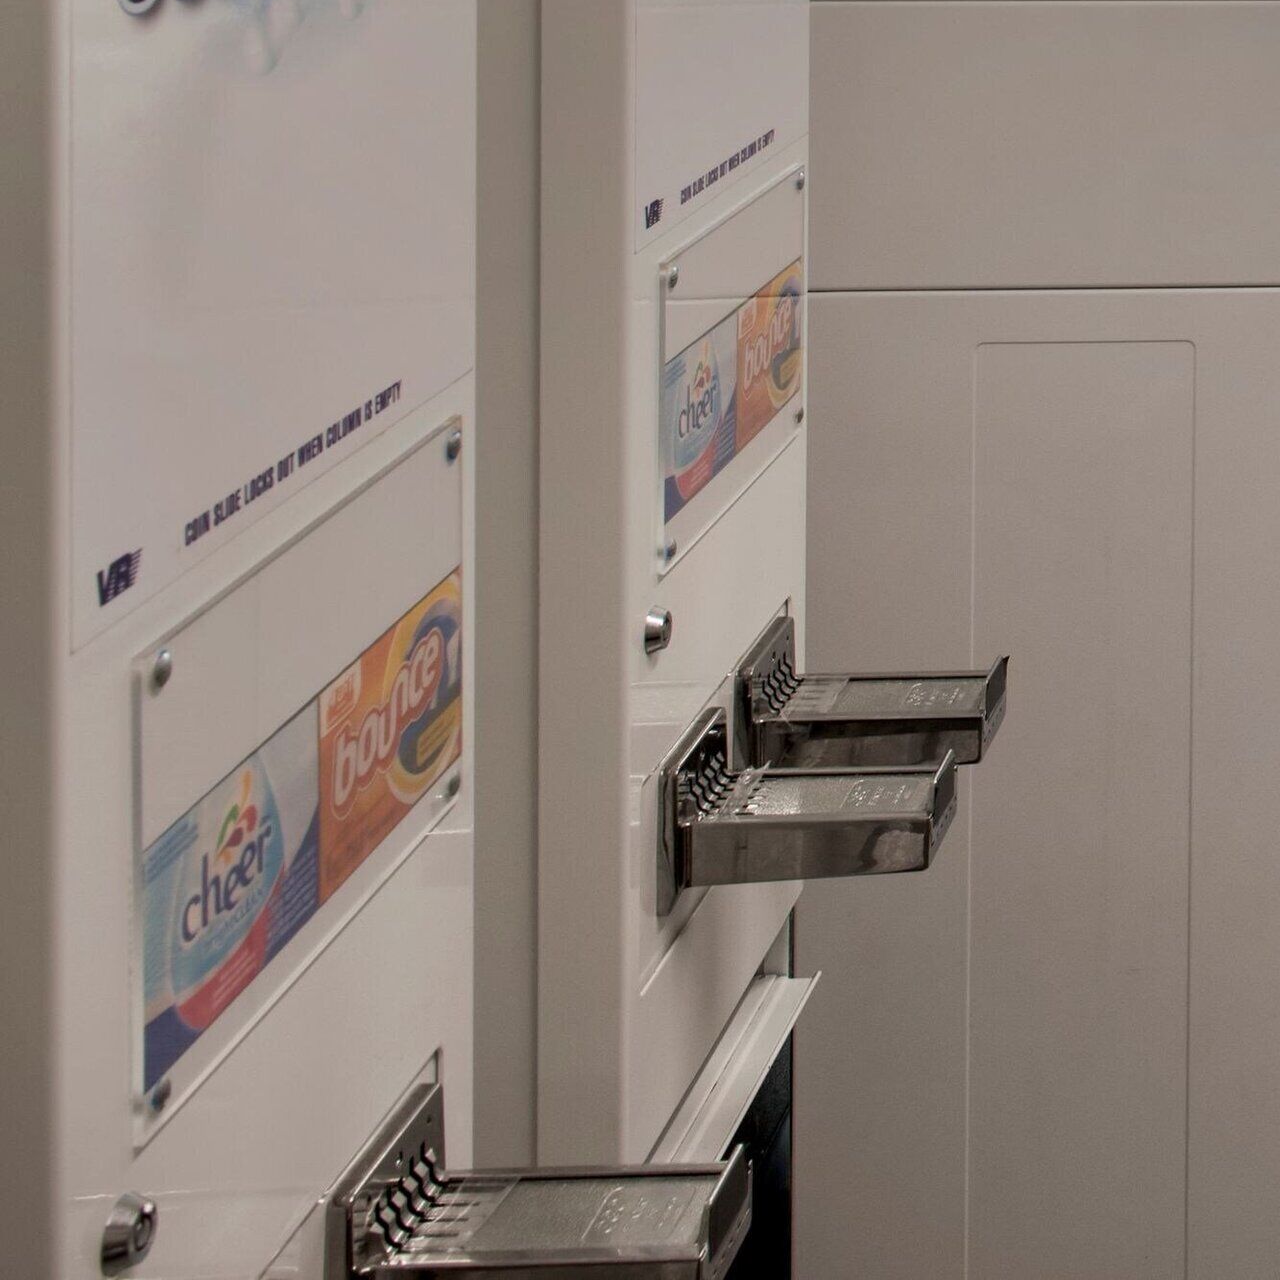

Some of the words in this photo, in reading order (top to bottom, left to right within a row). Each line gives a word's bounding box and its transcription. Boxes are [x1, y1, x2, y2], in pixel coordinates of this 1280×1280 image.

[743, 295, 792, 394] bounce
[185, 510, 210, 546] COIN
[213, 488, 242, 526] SLIDE
[244, 466, 274, 506] LOCKS
[277, 451, 295, 482] OUT
[298, 432, 323, 468] WHEN
[325, 406, 362, 449] COLUMN
[364, 399, 373, 422] IS
[375, 378, 403, 415] EMPTY
[677, 381, 718, 441] cheer
[332, 633, 441, 812] bounce
[180, 814, 272, 944] cheer
